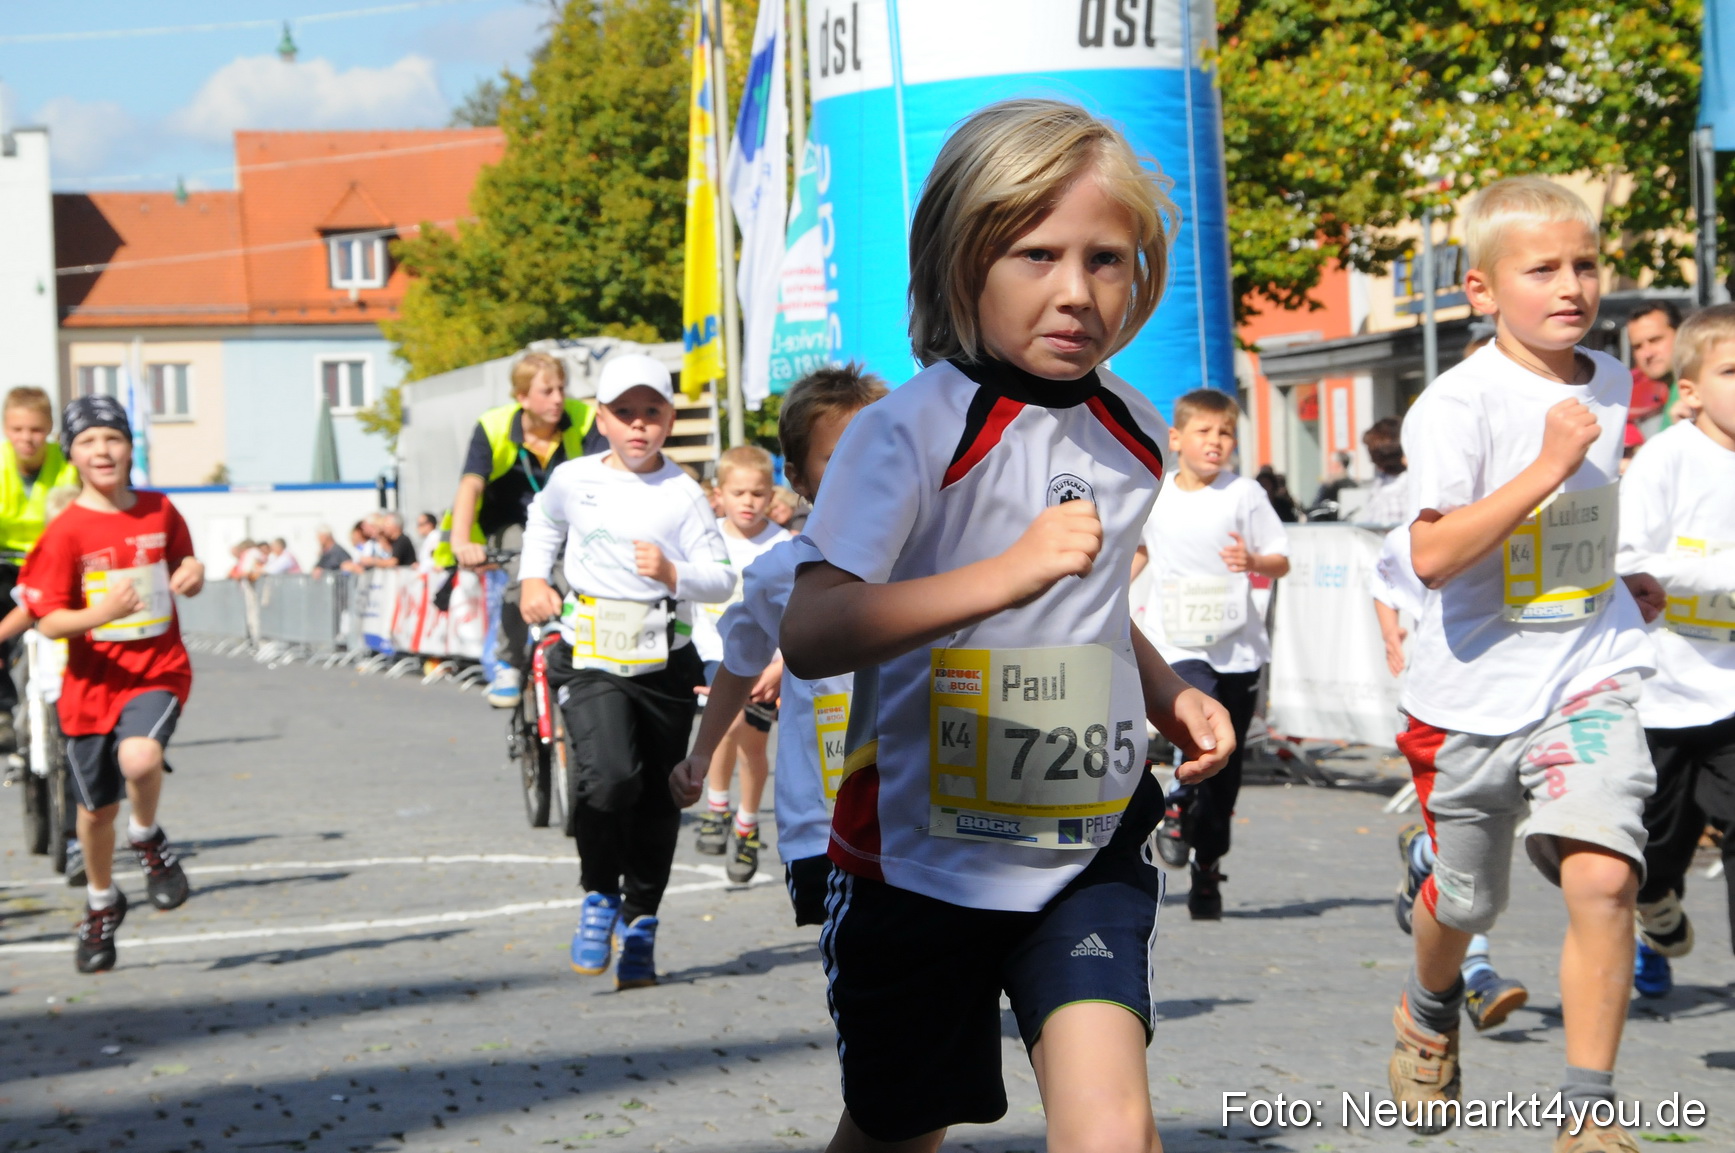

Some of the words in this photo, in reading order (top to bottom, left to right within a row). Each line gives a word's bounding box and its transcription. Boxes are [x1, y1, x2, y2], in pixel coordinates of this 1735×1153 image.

[820, 2, 862, 79] dsl
[1548, 501, 1599, 528] Lukas
[1510, 543, 1530, 563] K4
[1551, 535, 1615, 578] 701
[1185, 601, 1239, 623] 7256
[600, 629, 656, 651] 7013
[1002, 662, 1065, 702] Paul
[941, 720, 971, 749] K4
[1004, 720, 1136, 780] 7285
[956, 815, 1021, 834] BOCK
[1070, 947, 1114, 959] adidas
